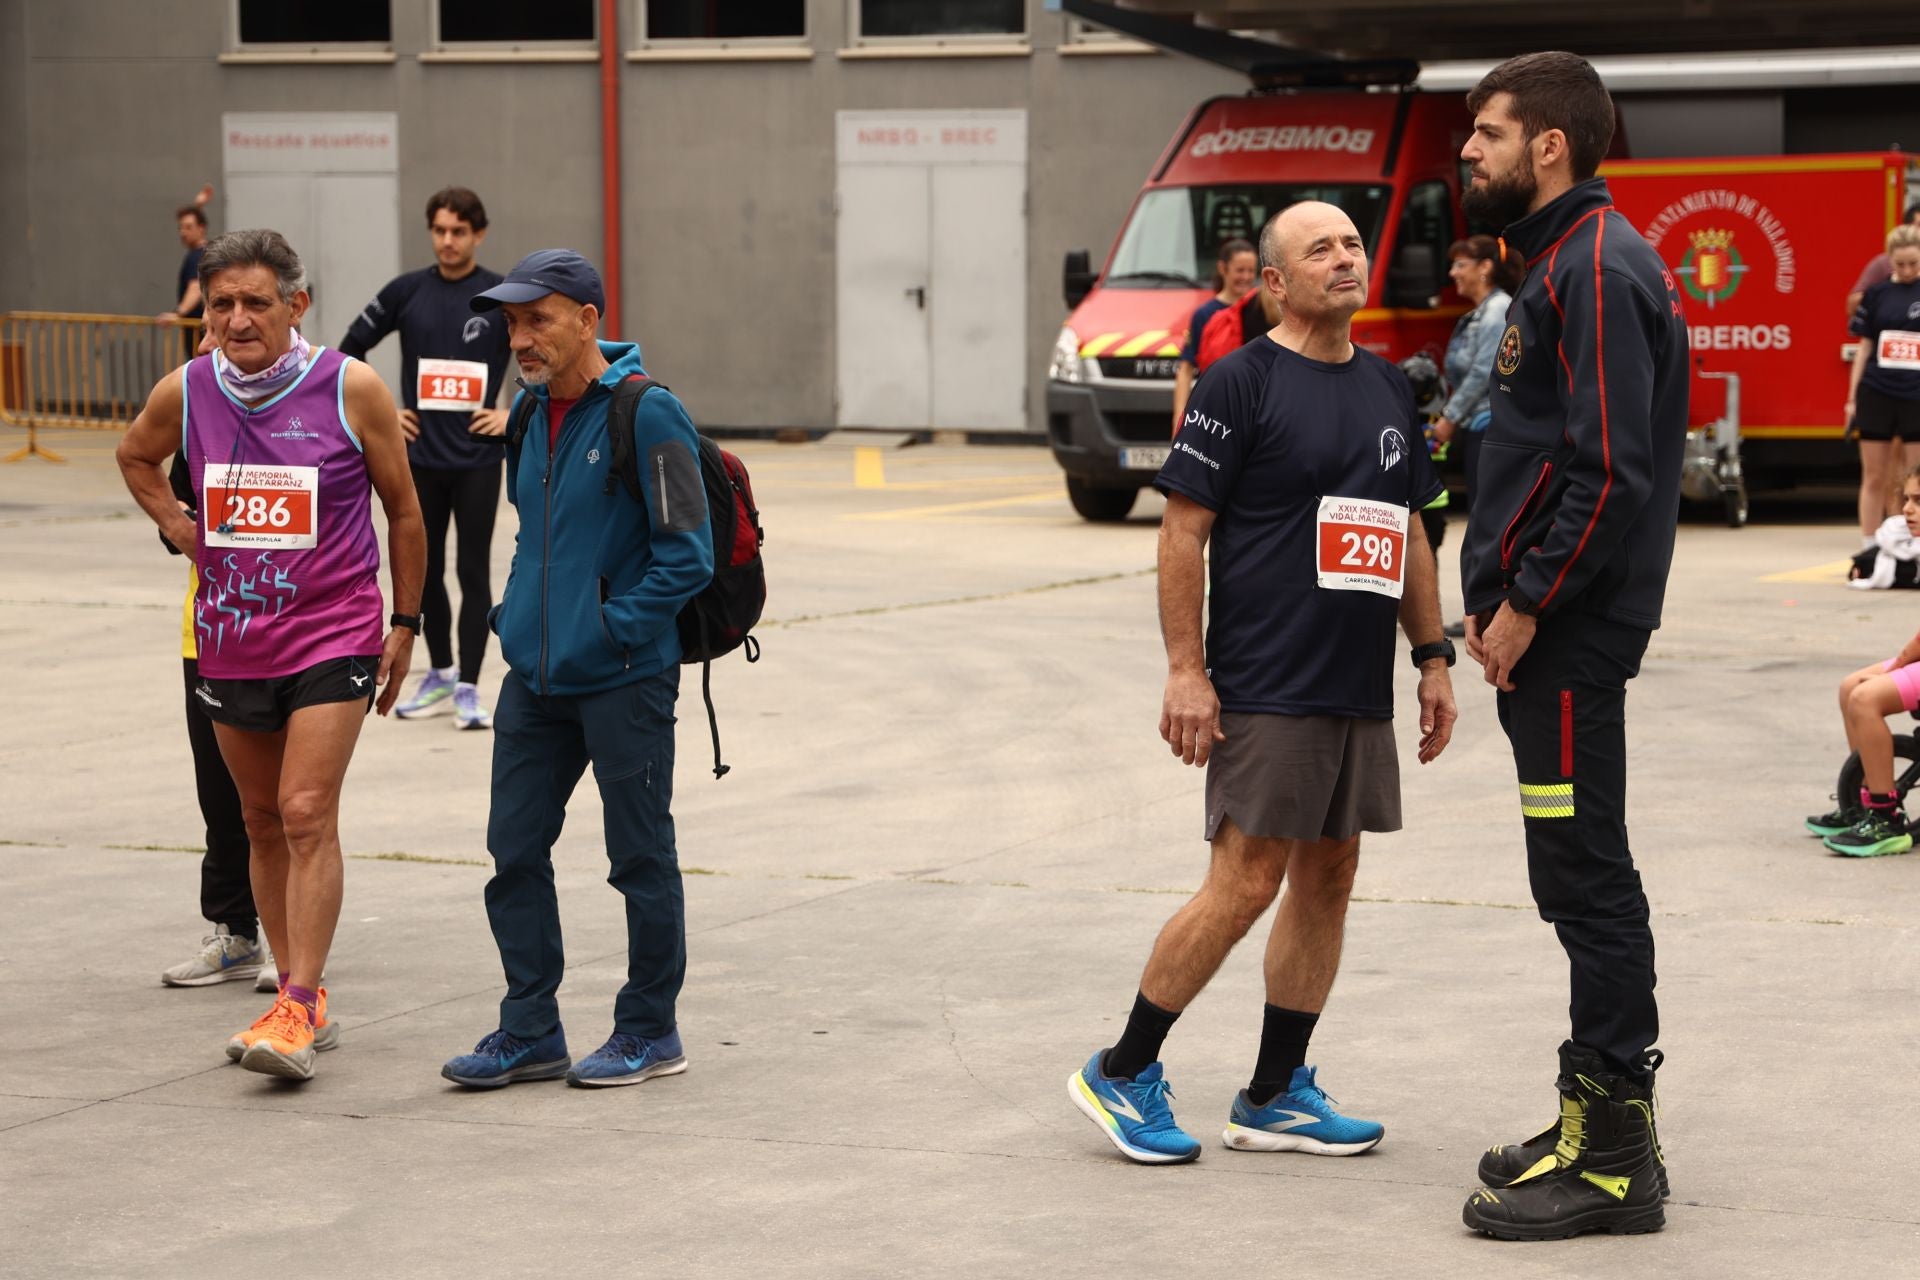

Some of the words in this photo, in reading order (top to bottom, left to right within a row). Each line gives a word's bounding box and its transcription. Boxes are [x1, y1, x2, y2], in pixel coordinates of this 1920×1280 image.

[1735, 194, 1760, 219] DE
[1687, 324, 1791, 350] BEROS
[430, 377, 471, 400] 181
[1181, 443, 1220, 470] Bomberos
[245, 471, 293, 480] MEMORIAL
[226, 495, 291, 527] 286
[1329, 512, 1401, 530] VIDAL-MATARRANZ
[1338, 504, 1358, 514] XXIX
[1359, 505, 1396, 520] MEMORIAL
[1340, 531, 1393, 571] 298
